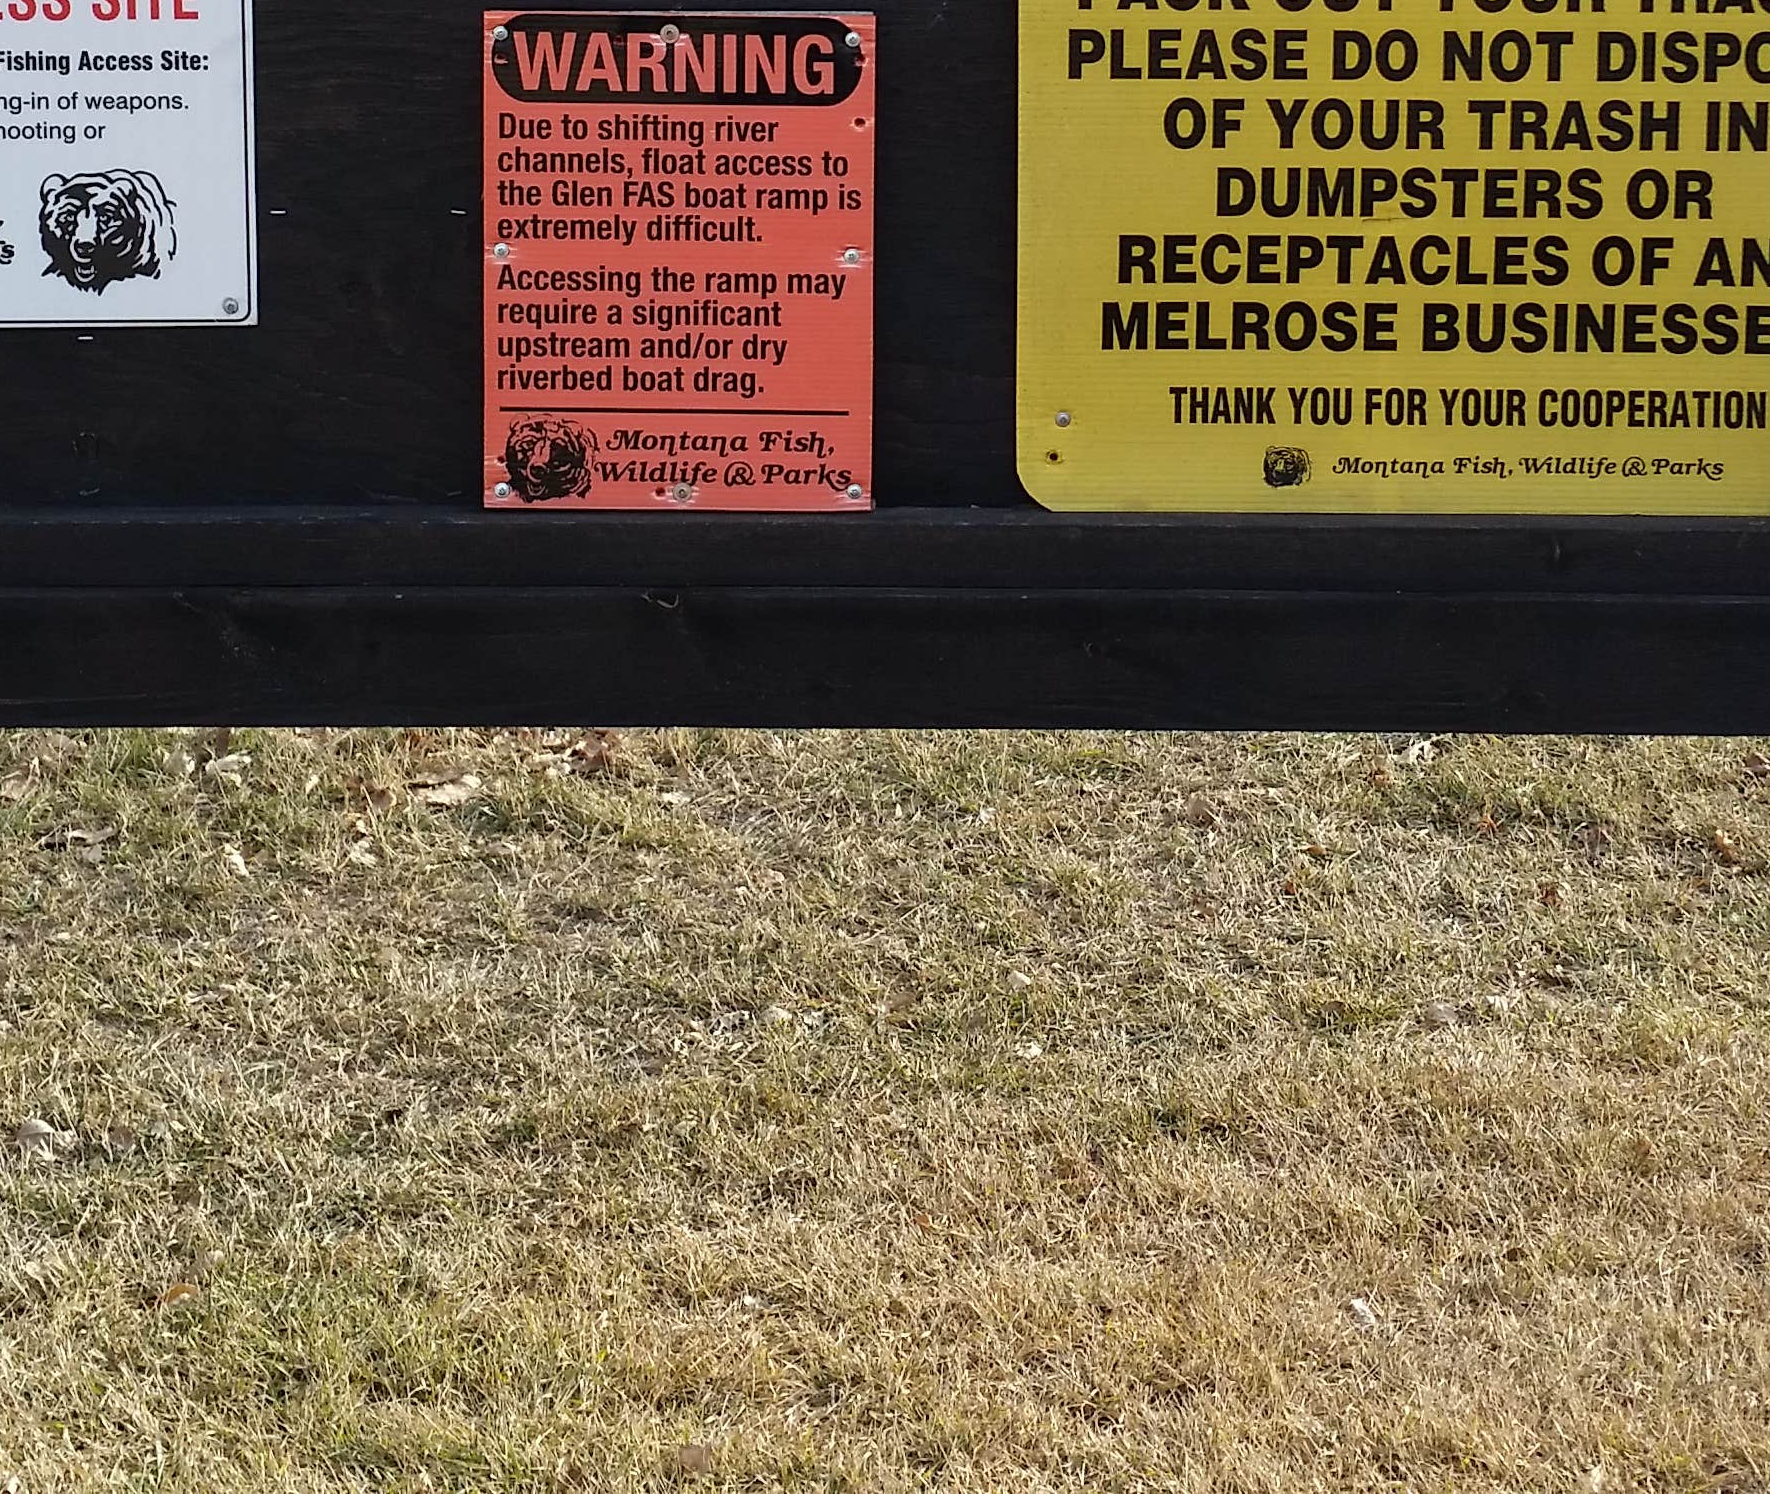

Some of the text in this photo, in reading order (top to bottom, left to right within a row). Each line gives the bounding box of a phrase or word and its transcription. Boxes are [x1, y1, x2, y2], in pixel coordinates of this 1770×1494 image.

[77, 50, 153, 71] Access
[160, 50, 209, 71] Site:
[511, 30, 836, 95] WARNING
[1068, 28, 1308, 81] PLEASE
[1331, 28, 1419, 82] DO
[1442, 29, 1574, 83] NOT
[57, 91, 79, 110] of
[84, 95, 189, 115] weapons.
[498, 112, 780, 148] Due to shifting river
[497, 145, 849, 180] channels, float access to
[1216, 166, 1713, 220] DUMPSTERS OR
[1101, 300, 1398, 352] MELROSE
[1332, 455, 1724, 482] Montana Fish, Wildlife & Parks
